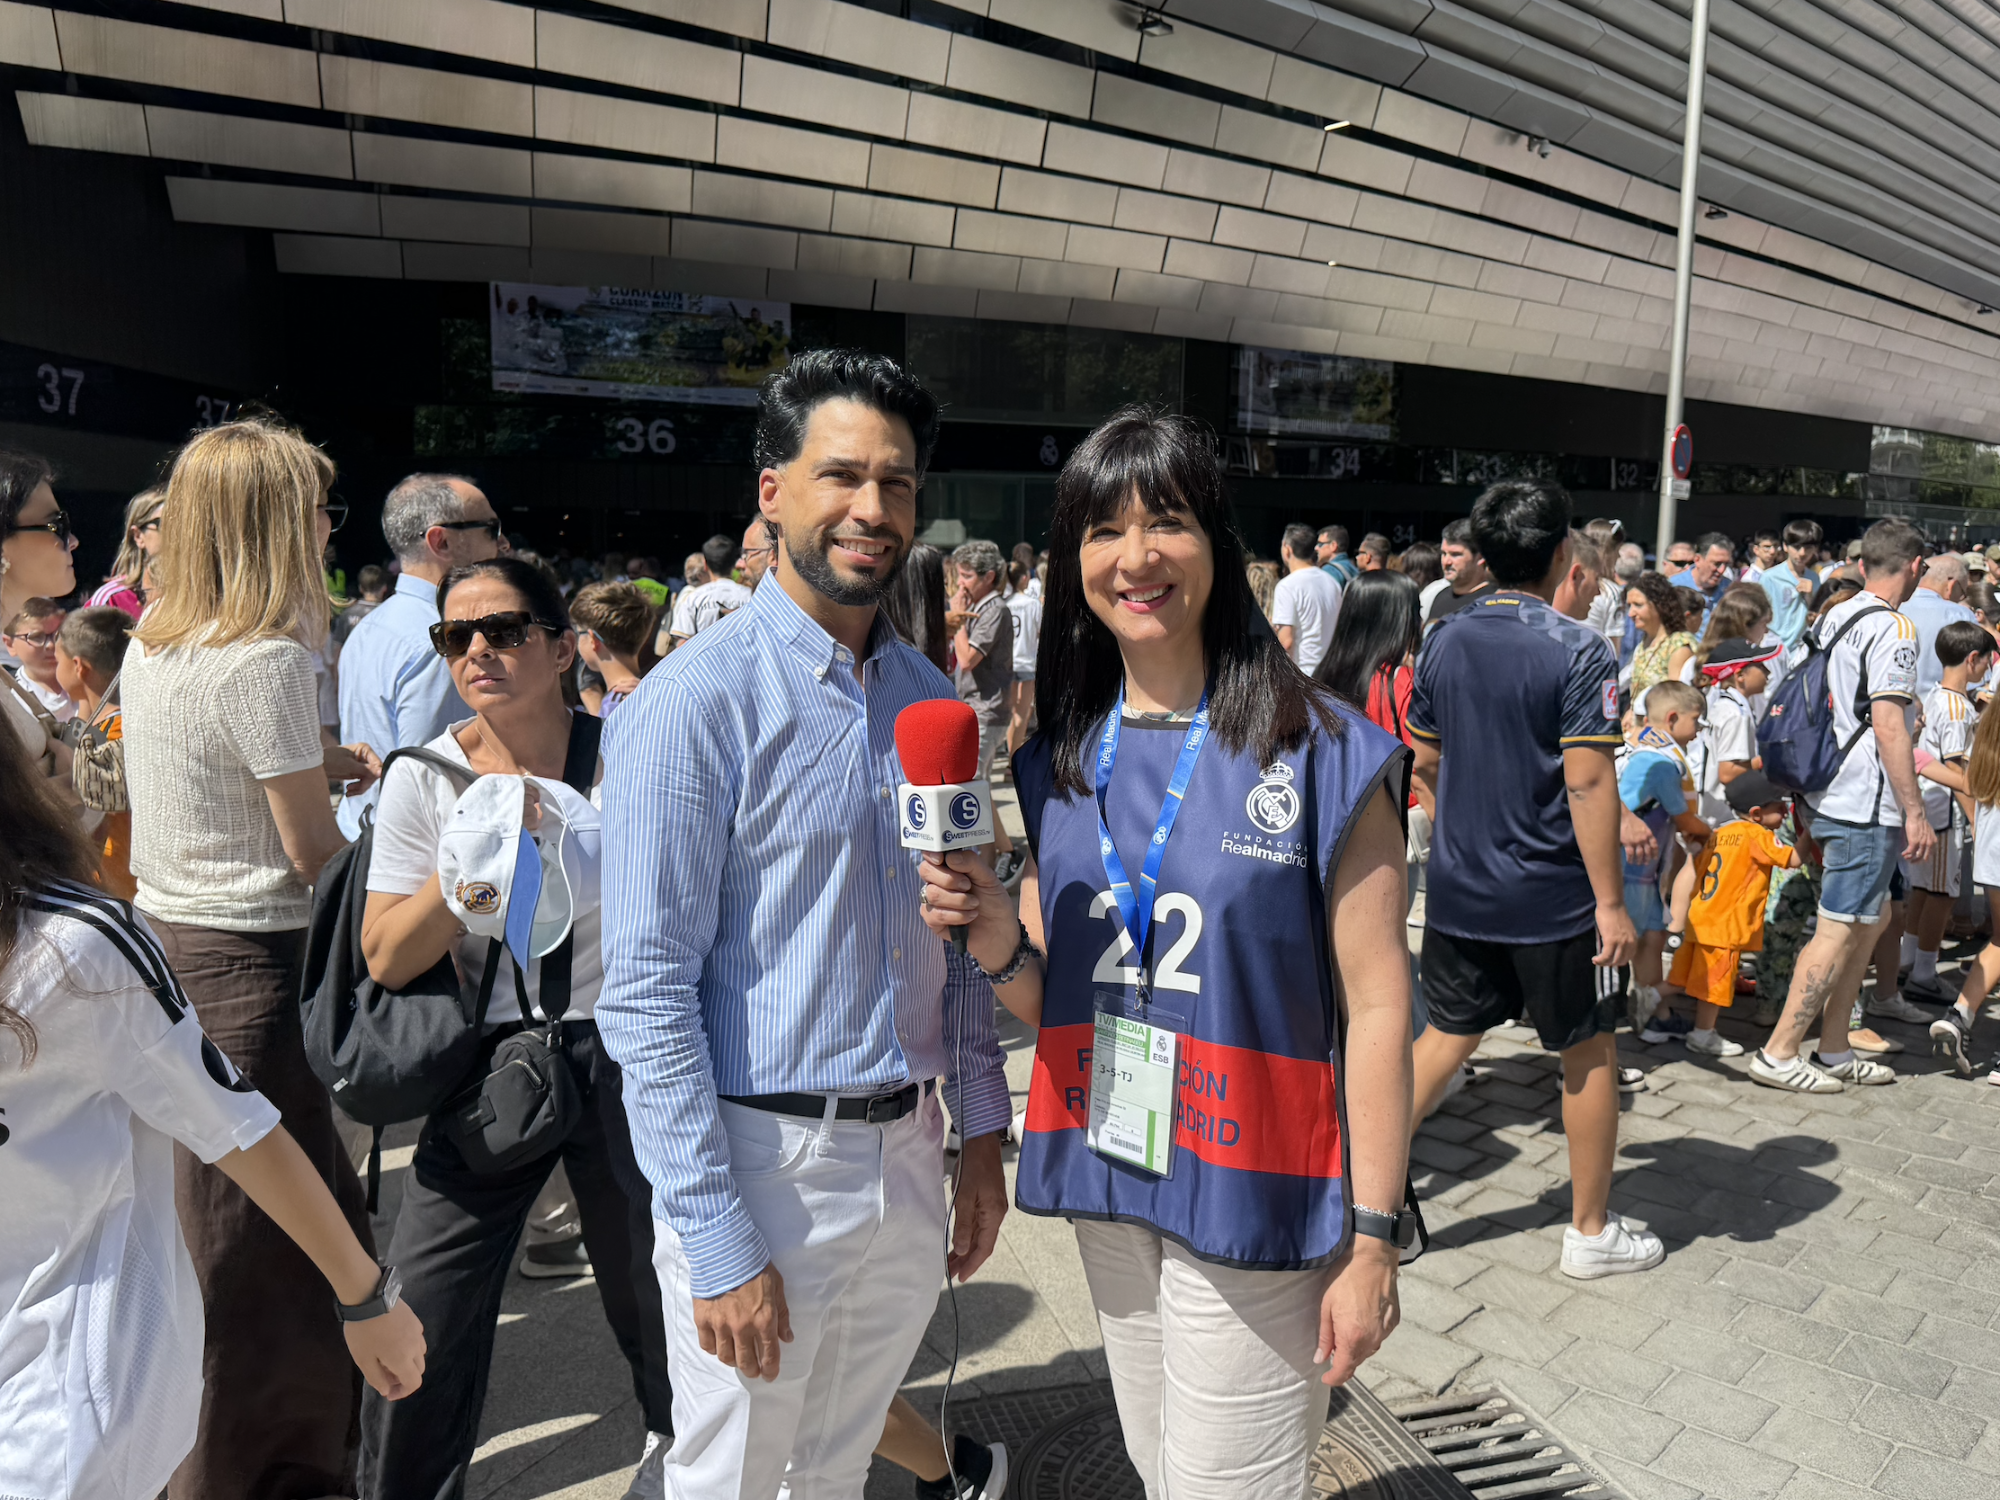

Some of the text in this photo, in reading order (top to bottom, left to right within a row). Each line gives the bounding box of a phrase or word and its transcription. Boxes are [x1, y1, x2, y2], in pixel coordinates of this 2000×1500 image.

[37, 363, 85, 416] 37
[196, 394, 230, 428] 37
[616, 417, 677, 455] 36
[1330, 447, 1361, 477] 34
[1617, 463, 1639, 486] 32
[1392, 523, 1416, 544] 34
[1099, 709, 1118, 767] Real Madrid
[1186, 726, 1203, 751] Real
[1700, 852, 1723, 901] 8
[1088, 889, 1203, 995] 22
[1097, 1012, 1145, 1037] TV/MEDIA
[1099, 1063, 1133, 1082] 3-5-TJ
[1152, 1052, 1169, 1065] ESB
[1176, 1106, 1241, 1147] ADRID
